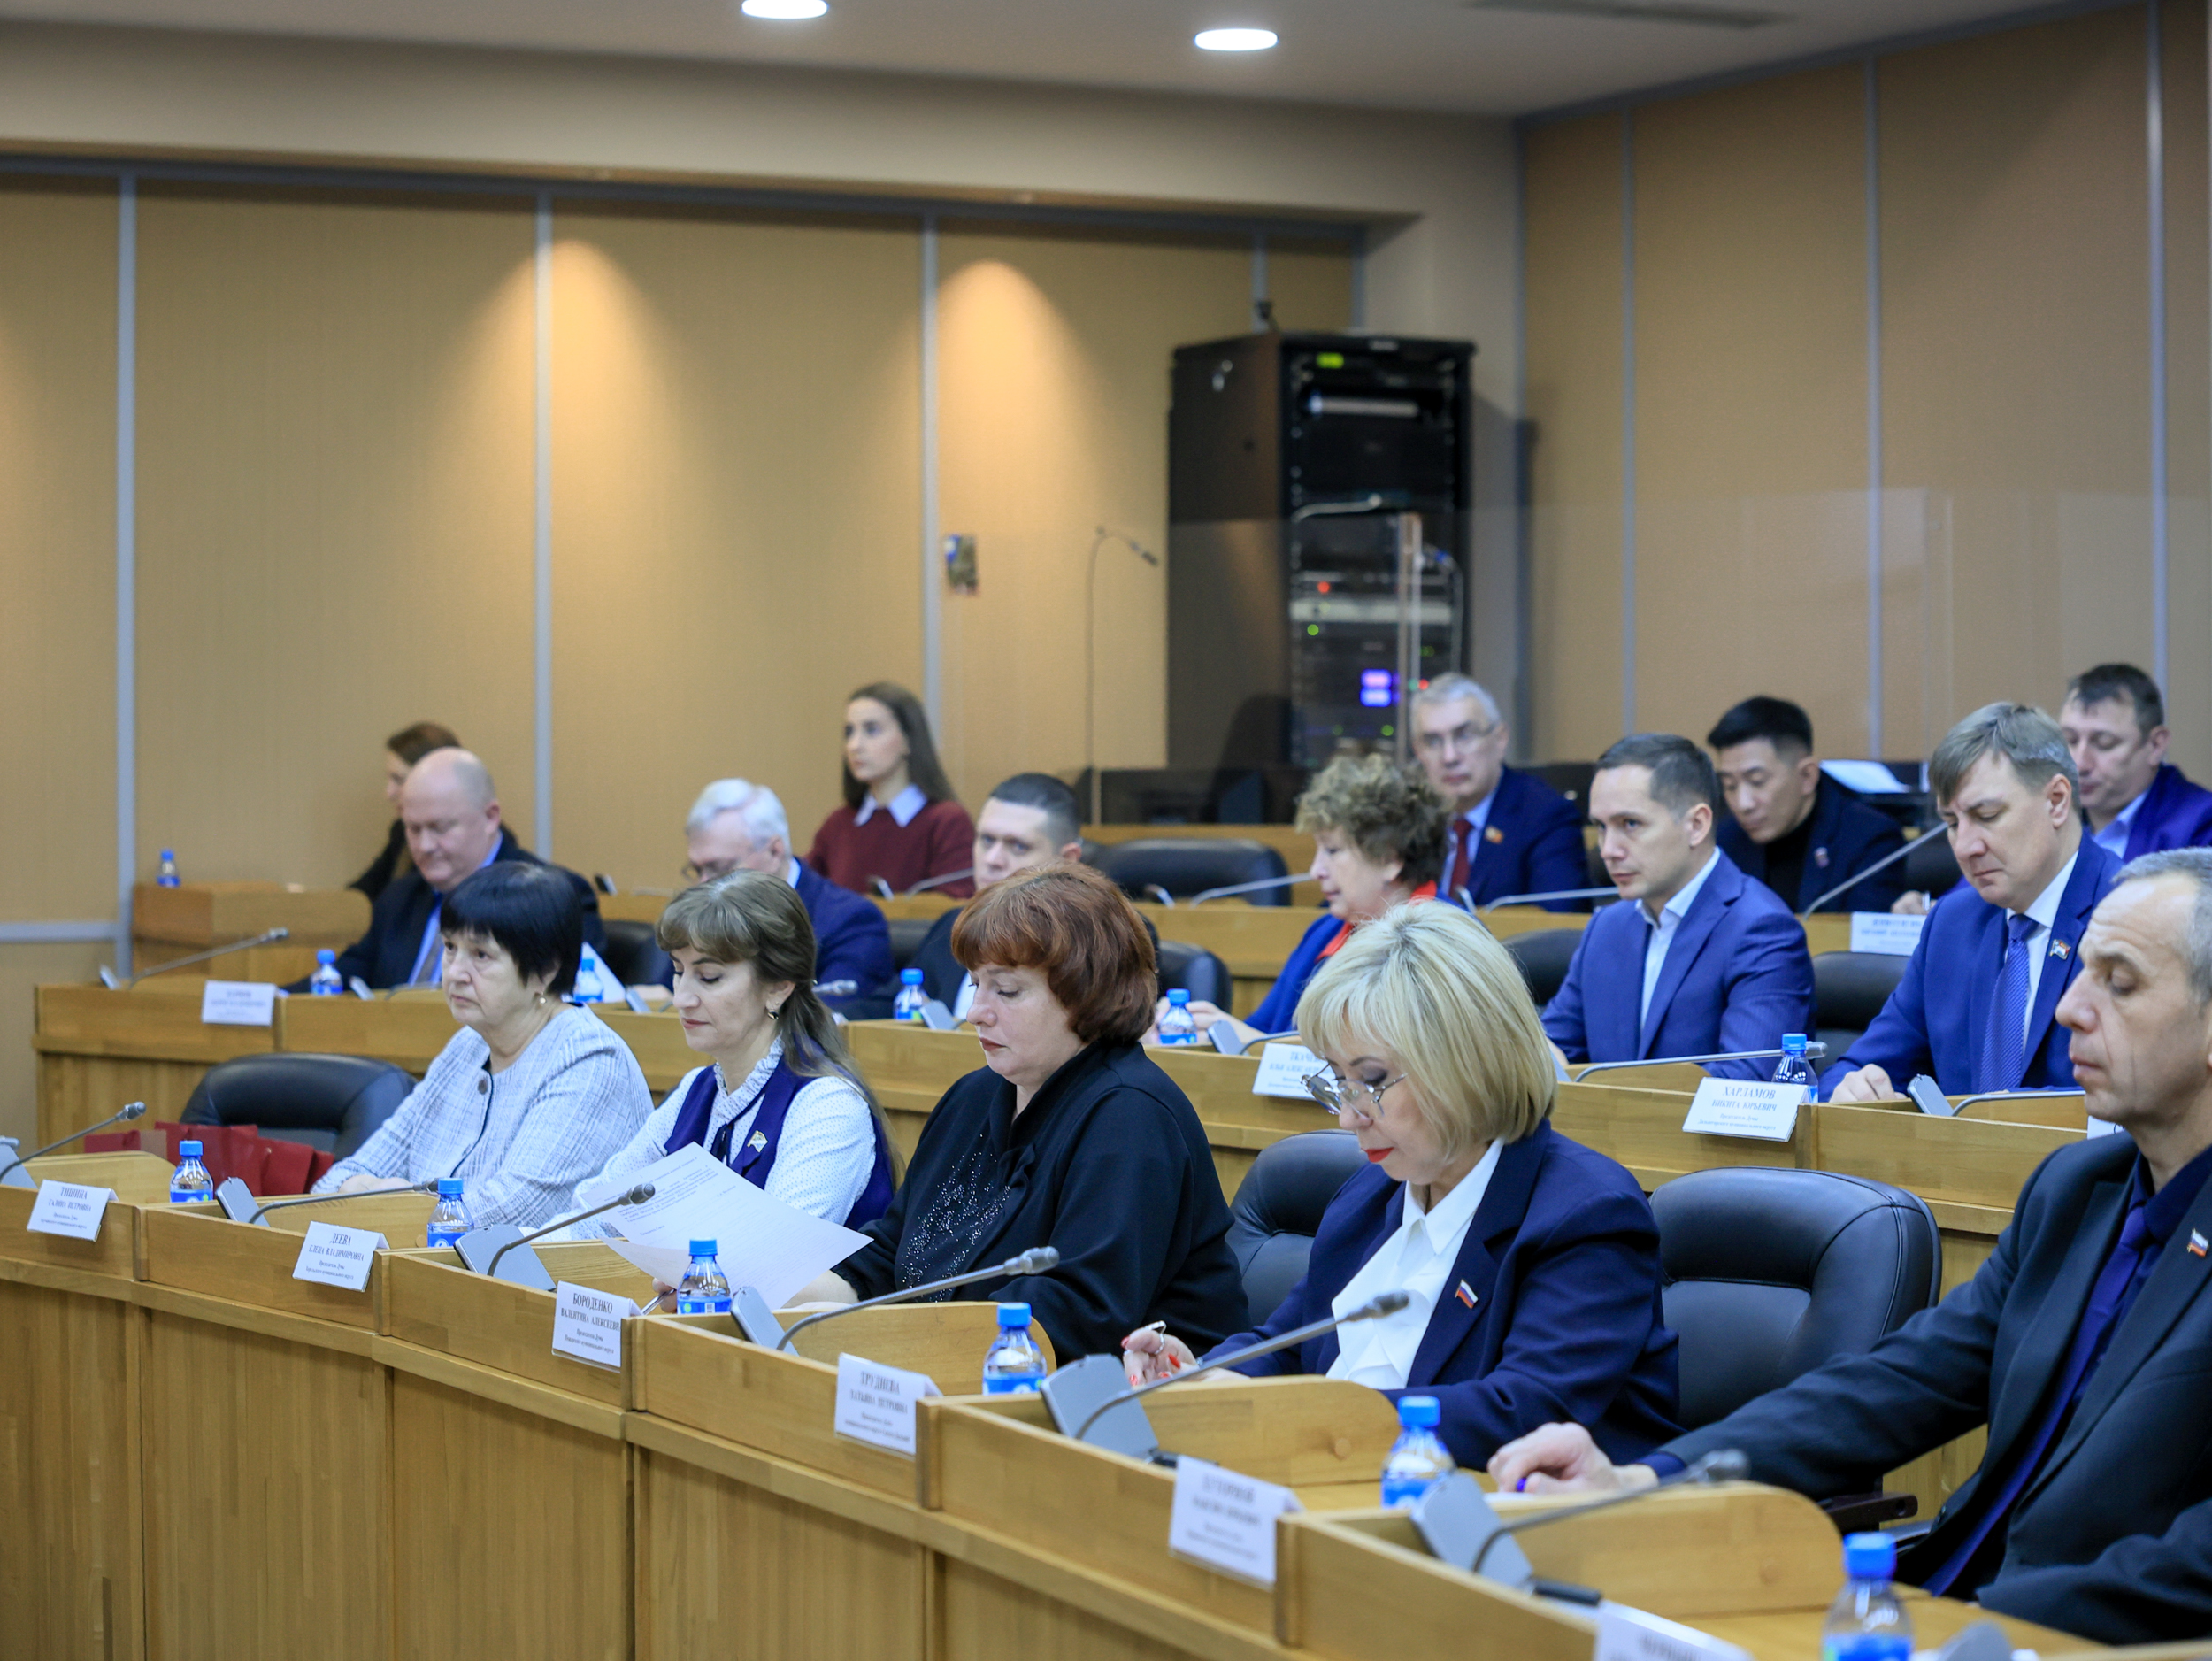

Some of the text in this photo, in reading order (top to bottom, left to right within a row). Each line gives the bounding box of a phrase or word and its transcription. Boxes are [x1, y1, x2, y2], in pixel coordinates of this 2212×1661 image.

[1722, 1086, 1777, 1100] ХАРЛАМОВ
[1711, 1099, 1778, 1112] НИКИТА ЮРЬЕВИЧ
[60, 1186, 88, 1200] ТИШИНА
[329, 1233, 352, 1246] ДЕЕВА
[308, 1244, 365, 1261] ЕЛЕНА ВЛАДИМИРОВНА
[572, 1292, 613, 1314] БОРОДЕНКО
[561, 1307, 620, 1332] ВАЛЕНТИНА АЛЕКСЕЕВН
[861, 1371, 900, 1395] ТРУДНЕВА
